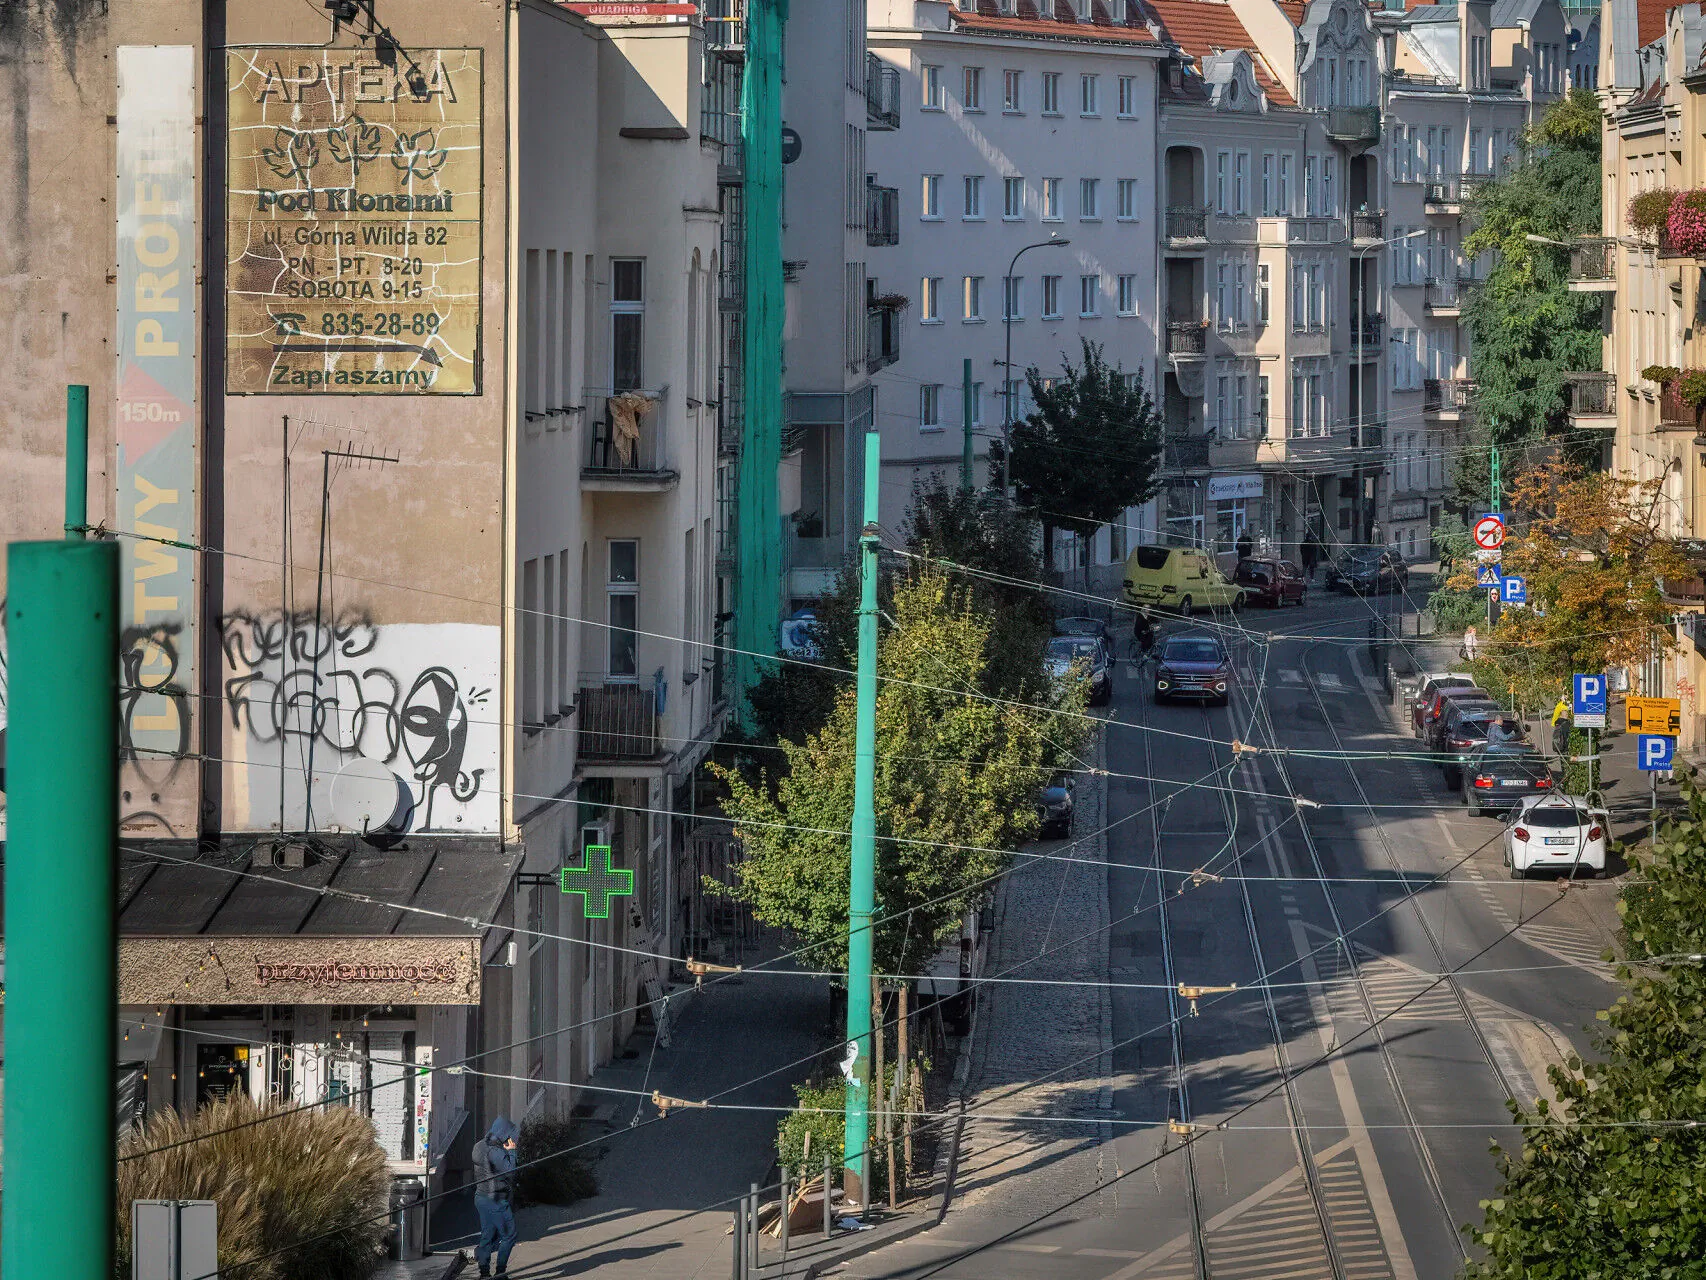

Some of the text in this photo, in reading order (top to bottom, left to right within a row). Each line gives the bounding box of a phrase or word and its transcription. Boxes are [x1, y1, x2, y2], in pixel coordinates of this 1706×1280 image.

[253, 59, 458, 104] APTEKA
[257, 188, 454, 212] Pod Klonami
[264, 227, 288, 246] ul.
[361, 226, 418, 246] Wilda
[424, 226, 448, 246] 82
[288, 257, 321, 276] PN.
[340, 257, 371, 276] PT.
[382, 257, 423, 276] 8-20
[288, 280, 423, 300] SOBOTA 9-15
[321, 312, 440, 336] 835-28-89
[273, 365, 434, 390] Zapraszamy
[120, 402, 181, 423] 150m
[1506, 579, 1521, 599] P
[1581, 677, 1599, 702] P
[1646, 738, 1666, 767] P
[255, 957, 457, 985] przyjemność
